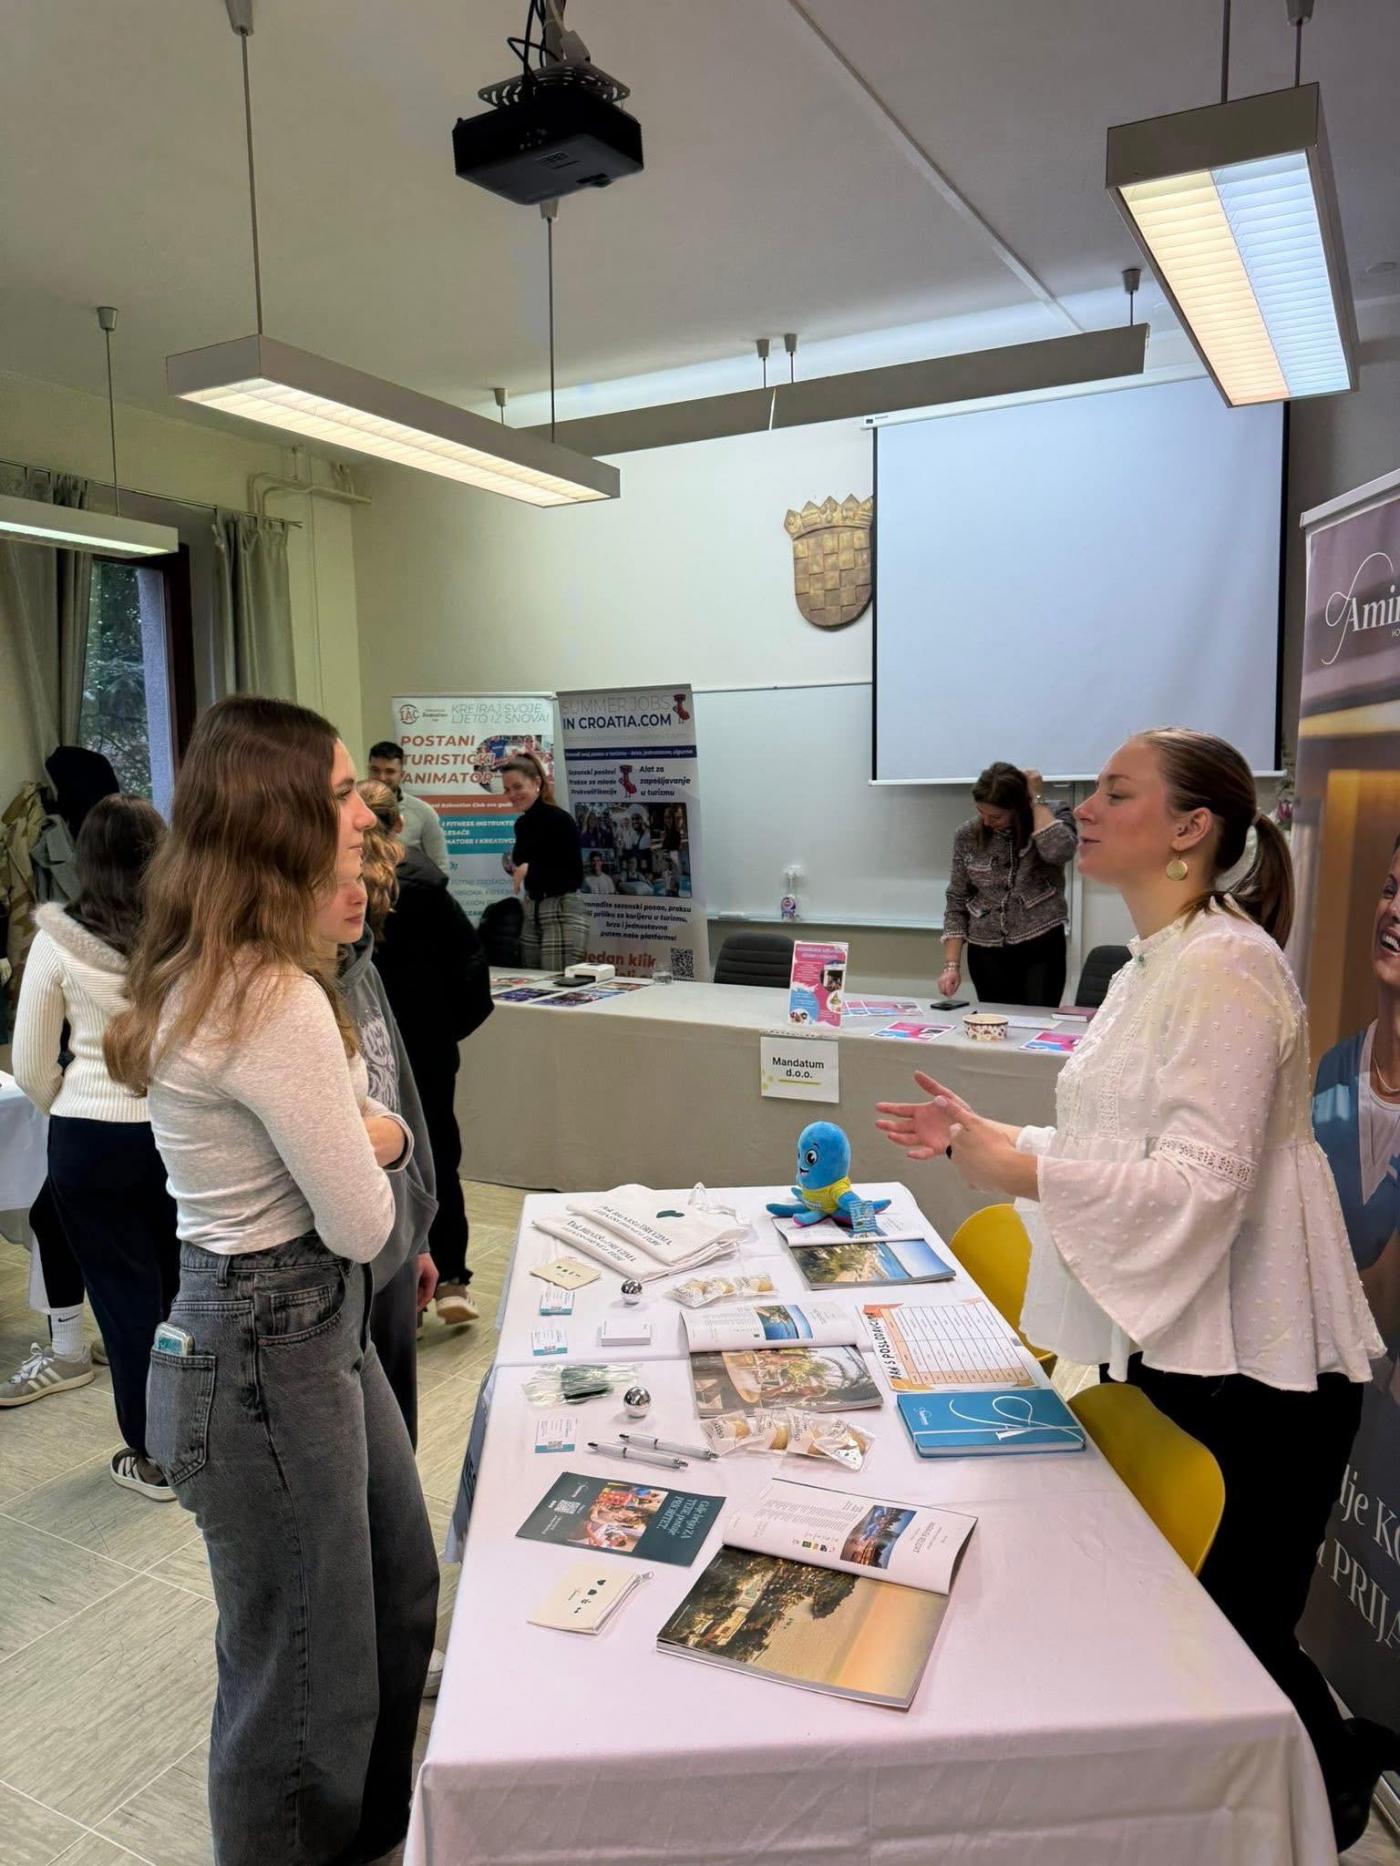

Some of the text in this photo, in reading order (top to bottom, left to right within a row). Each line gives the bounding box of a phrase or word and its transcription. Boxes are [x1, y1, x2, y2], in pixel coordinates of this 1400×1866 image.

[504, 703, 541, 713] SVOJE
[561, 694, 670, 714] SUMMER JOBS
[451, 714, 485, 724] LJETO
[490, 714, 500, 723] IZ
[504, 713, 550, 723] SNOVA!
[562, 714, 672, 730] IN CROATIA.COM
[400, 735, 475, 746] POSTANI
[402, 772, 493, 784] ANIMATOR
[628, 953, 656, 969] klik
[772, 1057, 824, 1069] Mandatum
[786, 1069, 813, 1078] d.o.o.
